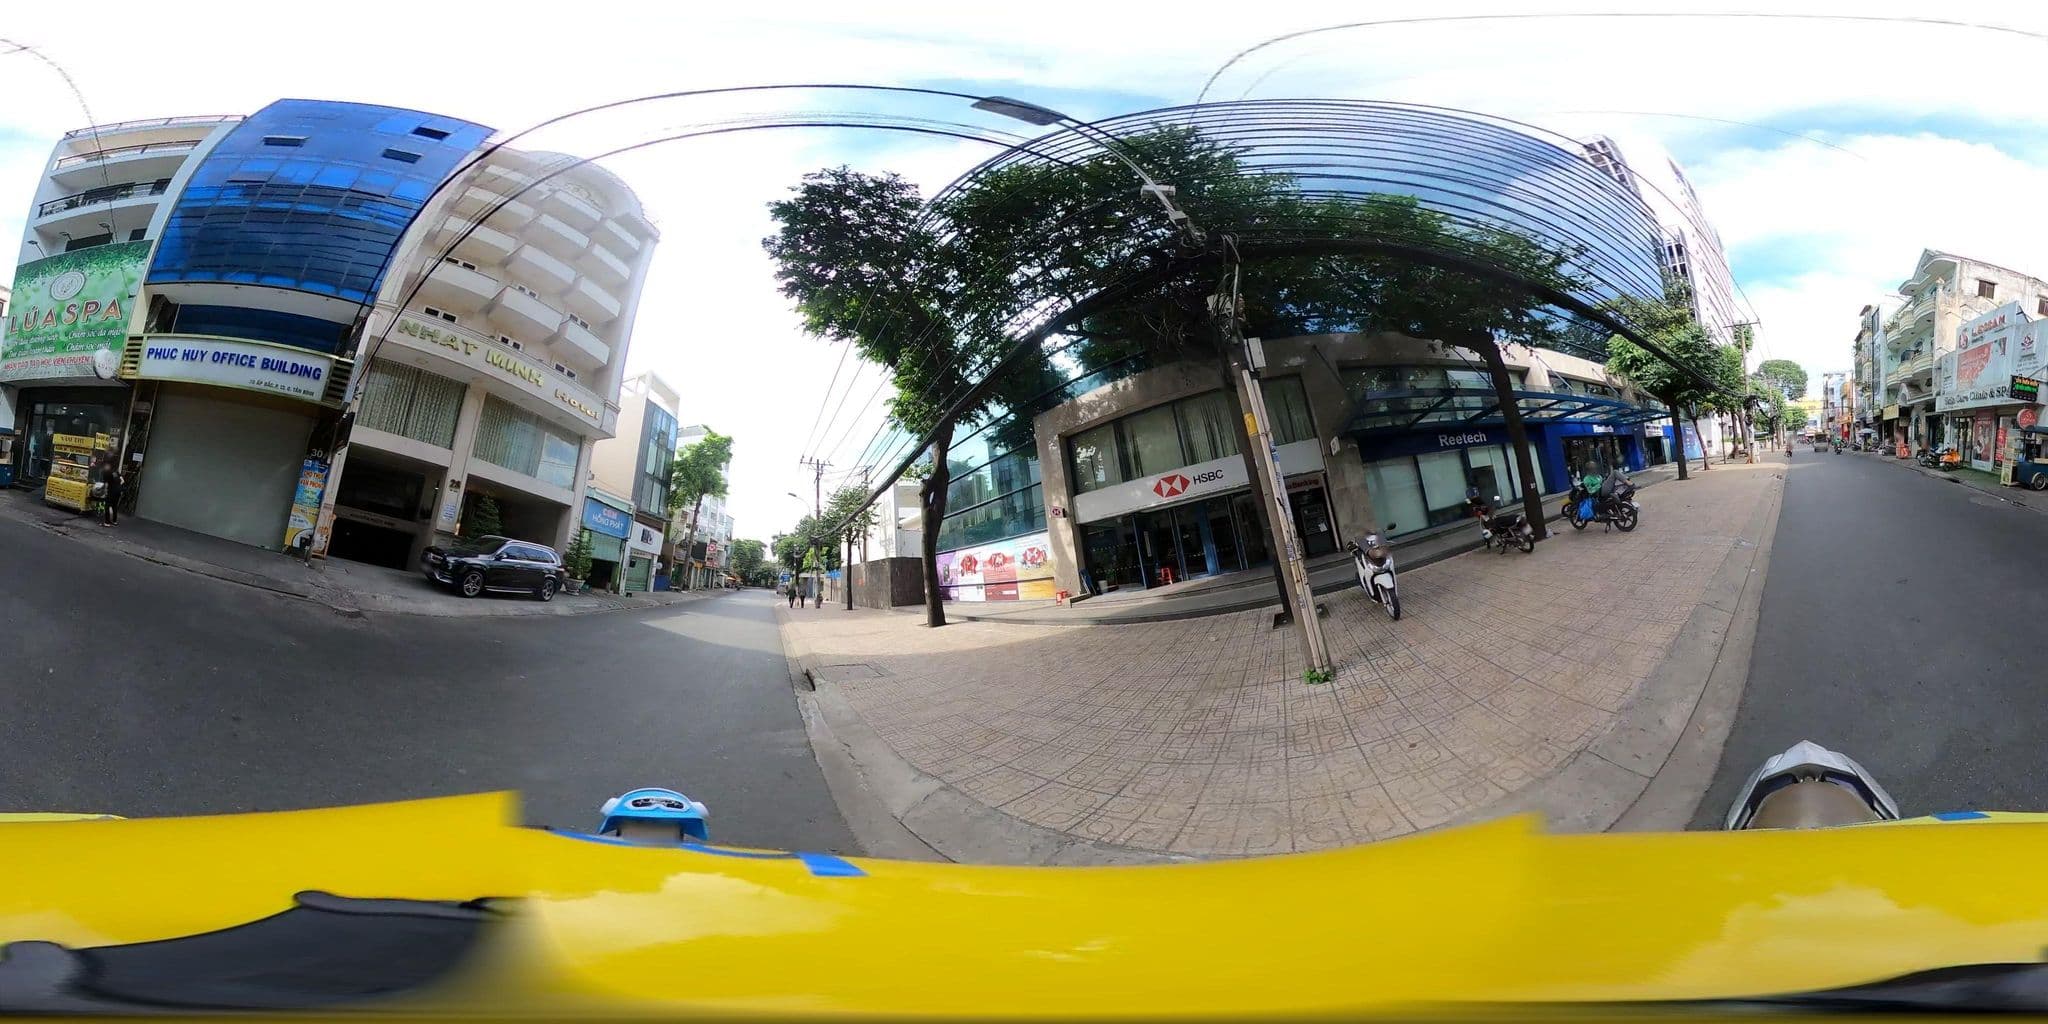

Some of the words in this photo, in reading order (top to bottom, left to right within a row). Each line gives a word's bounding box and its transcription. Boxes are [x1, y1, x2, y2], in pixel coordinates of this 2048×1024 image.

[182, 349, 208, 362] HUY
[212, 351, 257, 368] OFFICE
[261, 357, 322, 380] BUILDING
[485, 349, 544, 387] MINH
[554, 388, 600, 420] Hotel
[1438, 431, 1487, 447] Reetech
[311, 448, 324, 458] 30
[1193, 469, 1224, 485] HSBC
